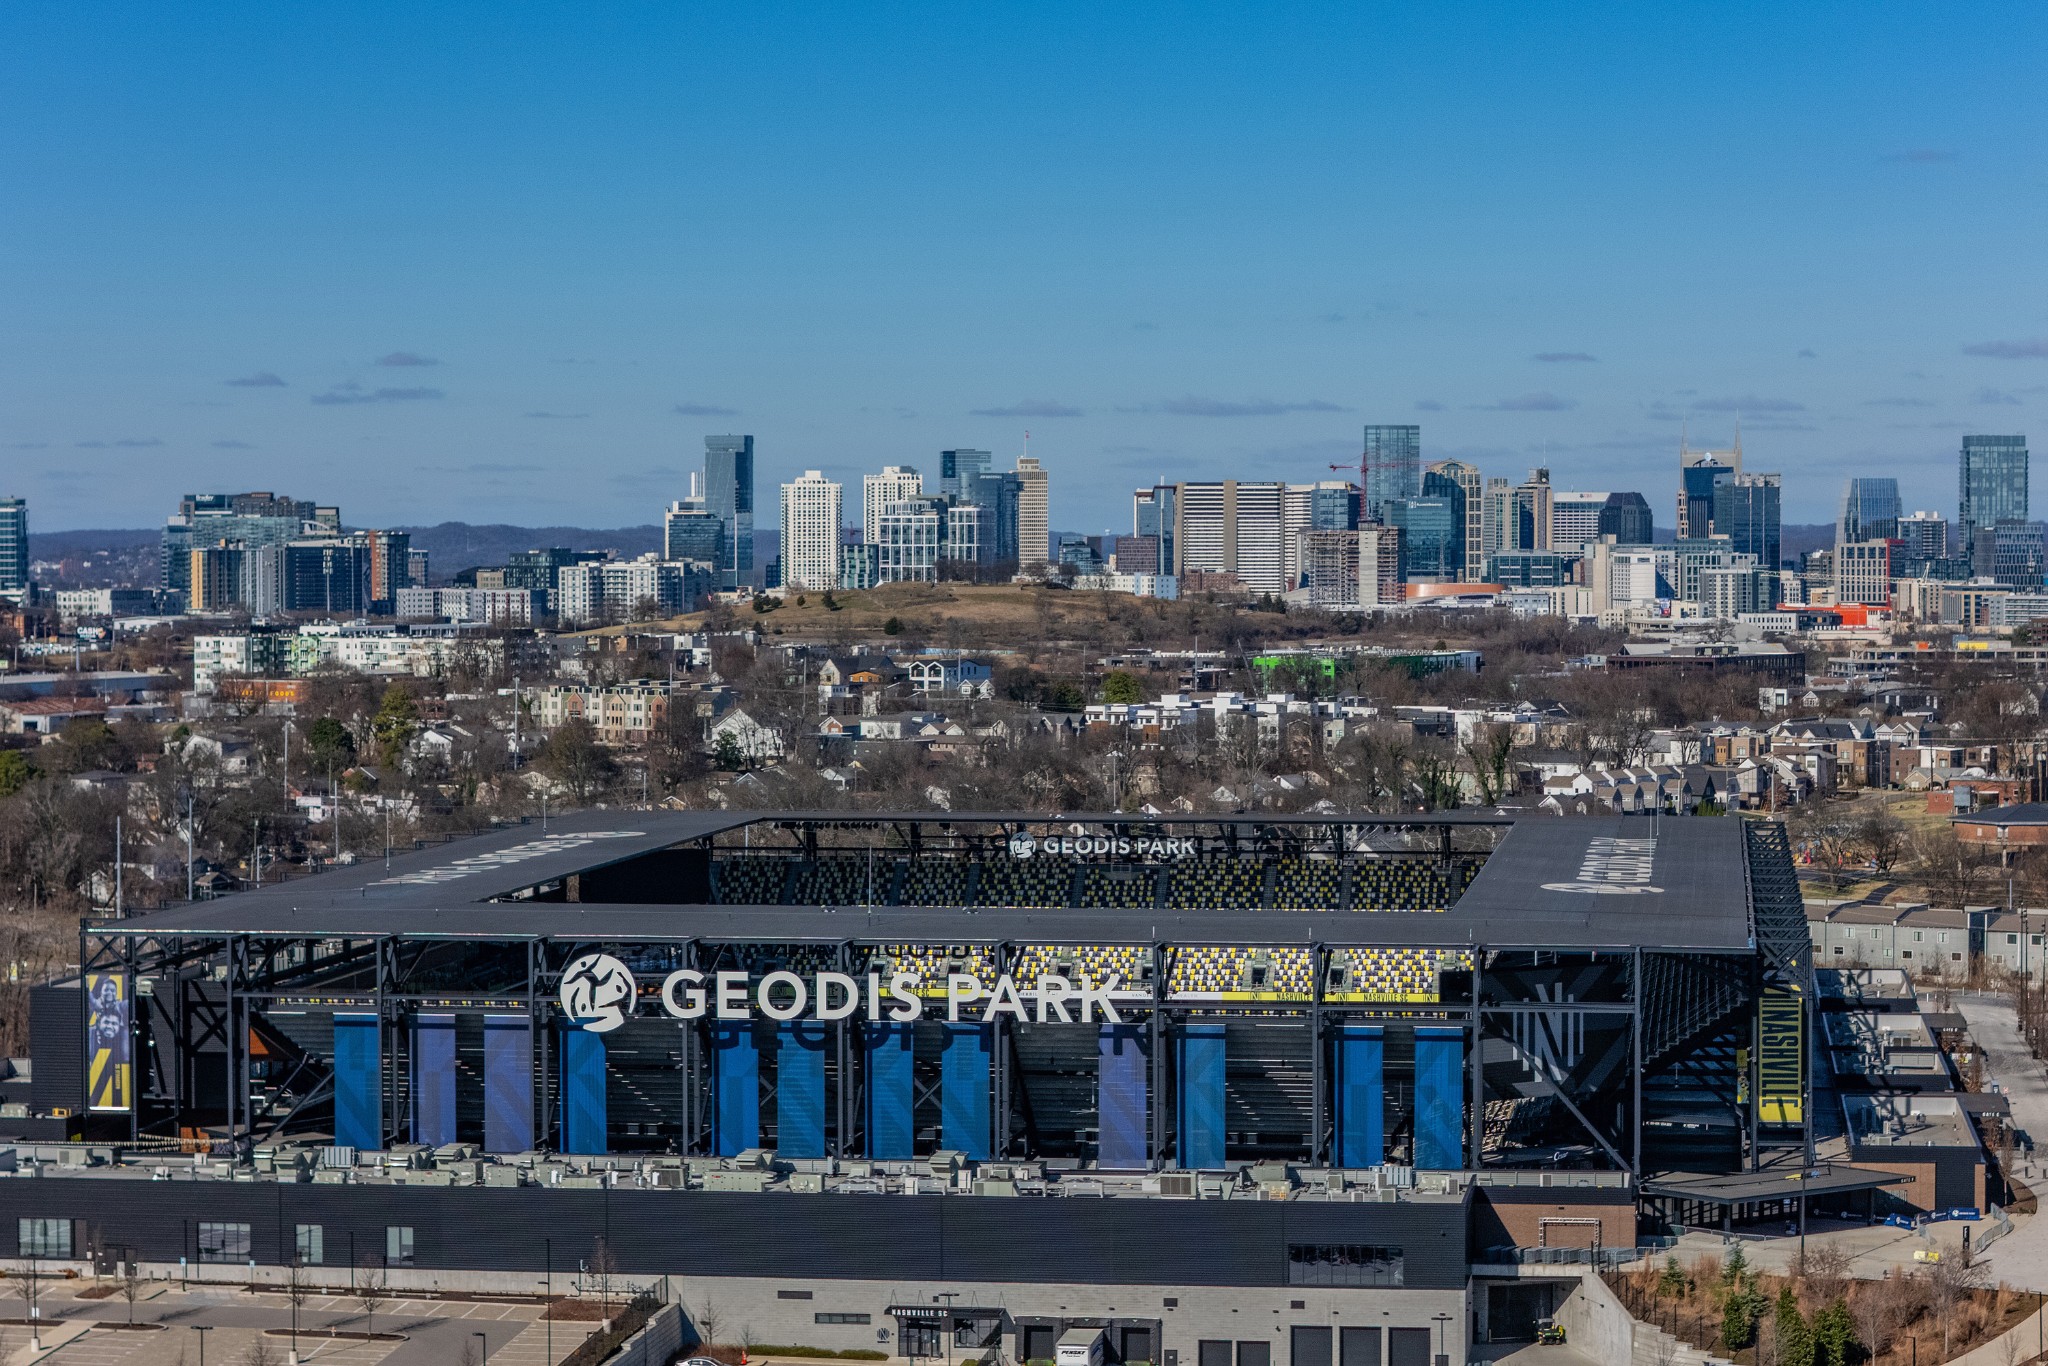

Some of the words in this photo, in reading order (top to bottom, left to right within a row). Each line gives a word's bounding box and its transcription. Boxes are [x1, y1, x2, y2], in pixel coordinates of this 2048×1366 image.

[1043, 837, 1131, 854] GEODIS
[1137, 838, 1196, 854] PARK
[661, 969, 922, 1021] GEODIS
[948, 973, 1123, 1022] PARK
[1363, 993, 1397, 1002] NASHVILLE
[1399, 993, 1408, 1002] SC
[1761, 1009, 1799, 1107] NASHVILLE
